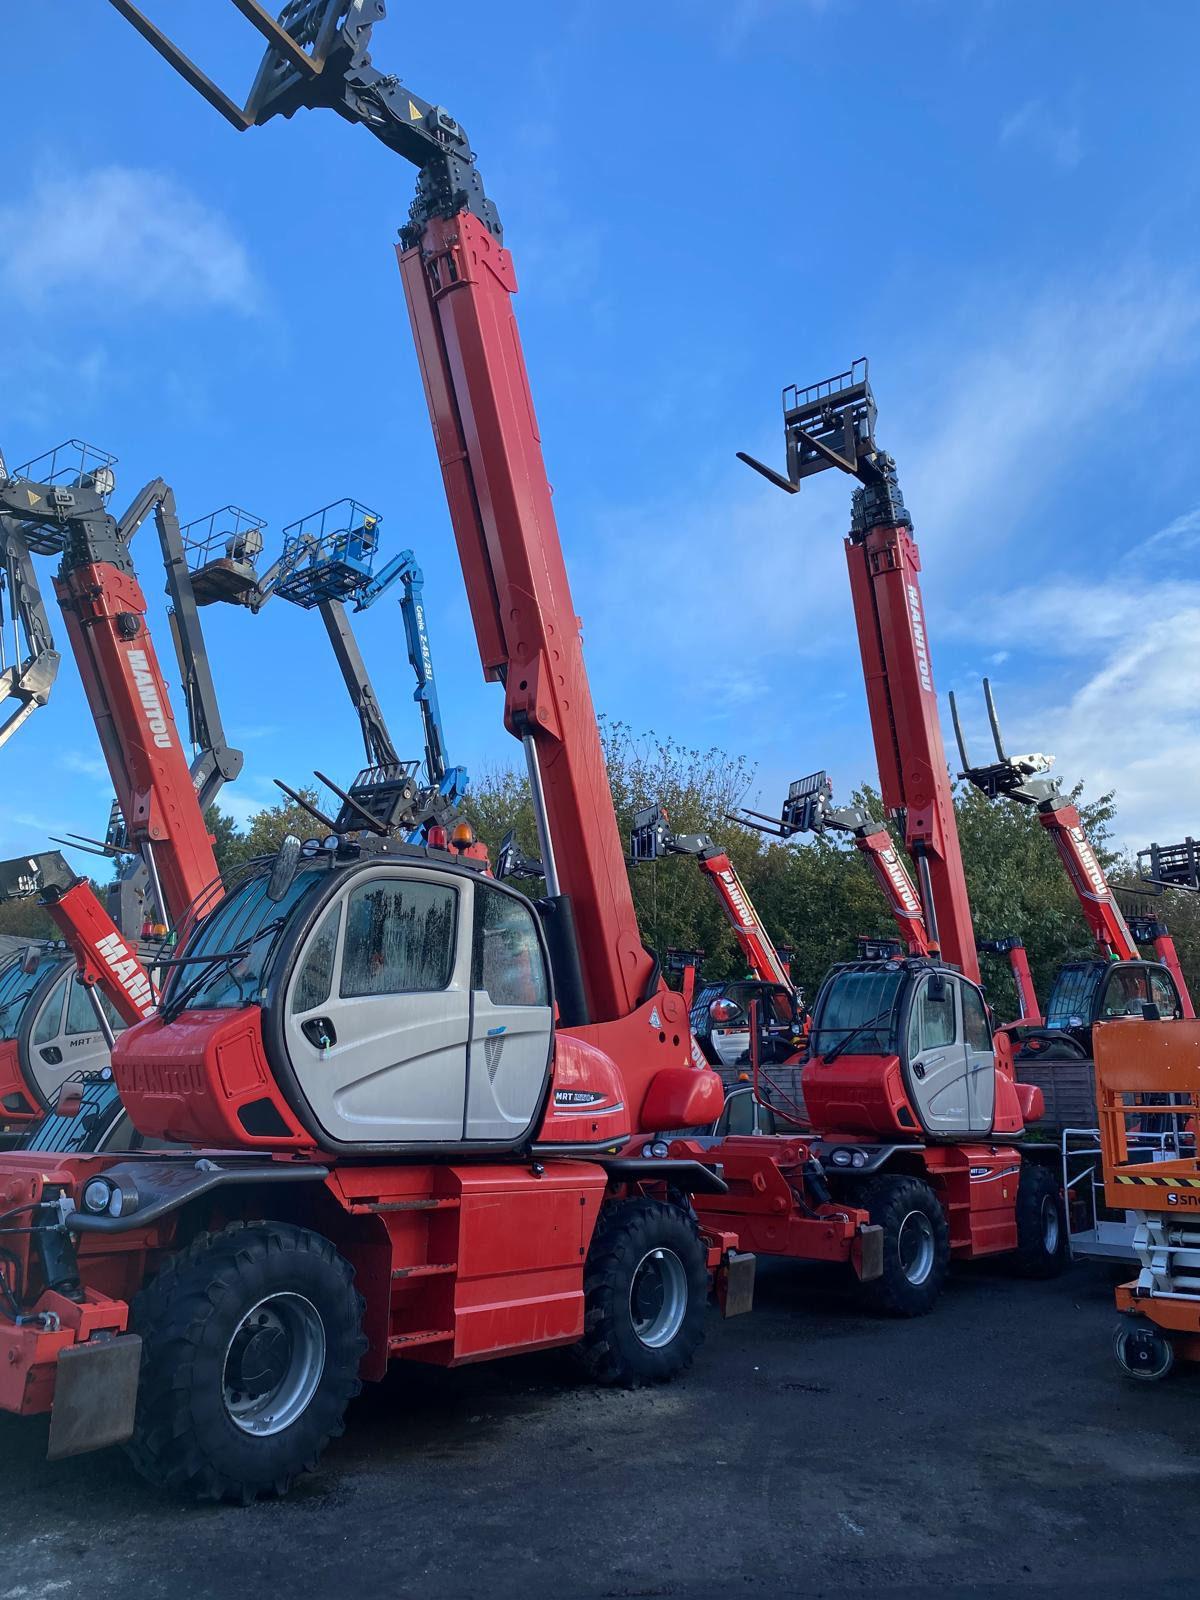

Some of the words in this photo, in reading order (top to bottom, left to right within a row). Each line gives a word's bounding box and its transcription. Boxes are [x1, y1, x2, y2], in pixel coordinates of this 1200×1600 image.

[416, 605, 425, 632] Genie
[907, 584, 932, 693] MANITOU
[126, 649, 173, 749] MANITOU
[880, 849, 919, 911] MANITOU
[1070, 826, 1108, 895] MANITOU
[719, 870, 755, 926] MANITOU
[70, 1037, 92, 1048] MRT
[556, 1092, 573, 1101] MRT
